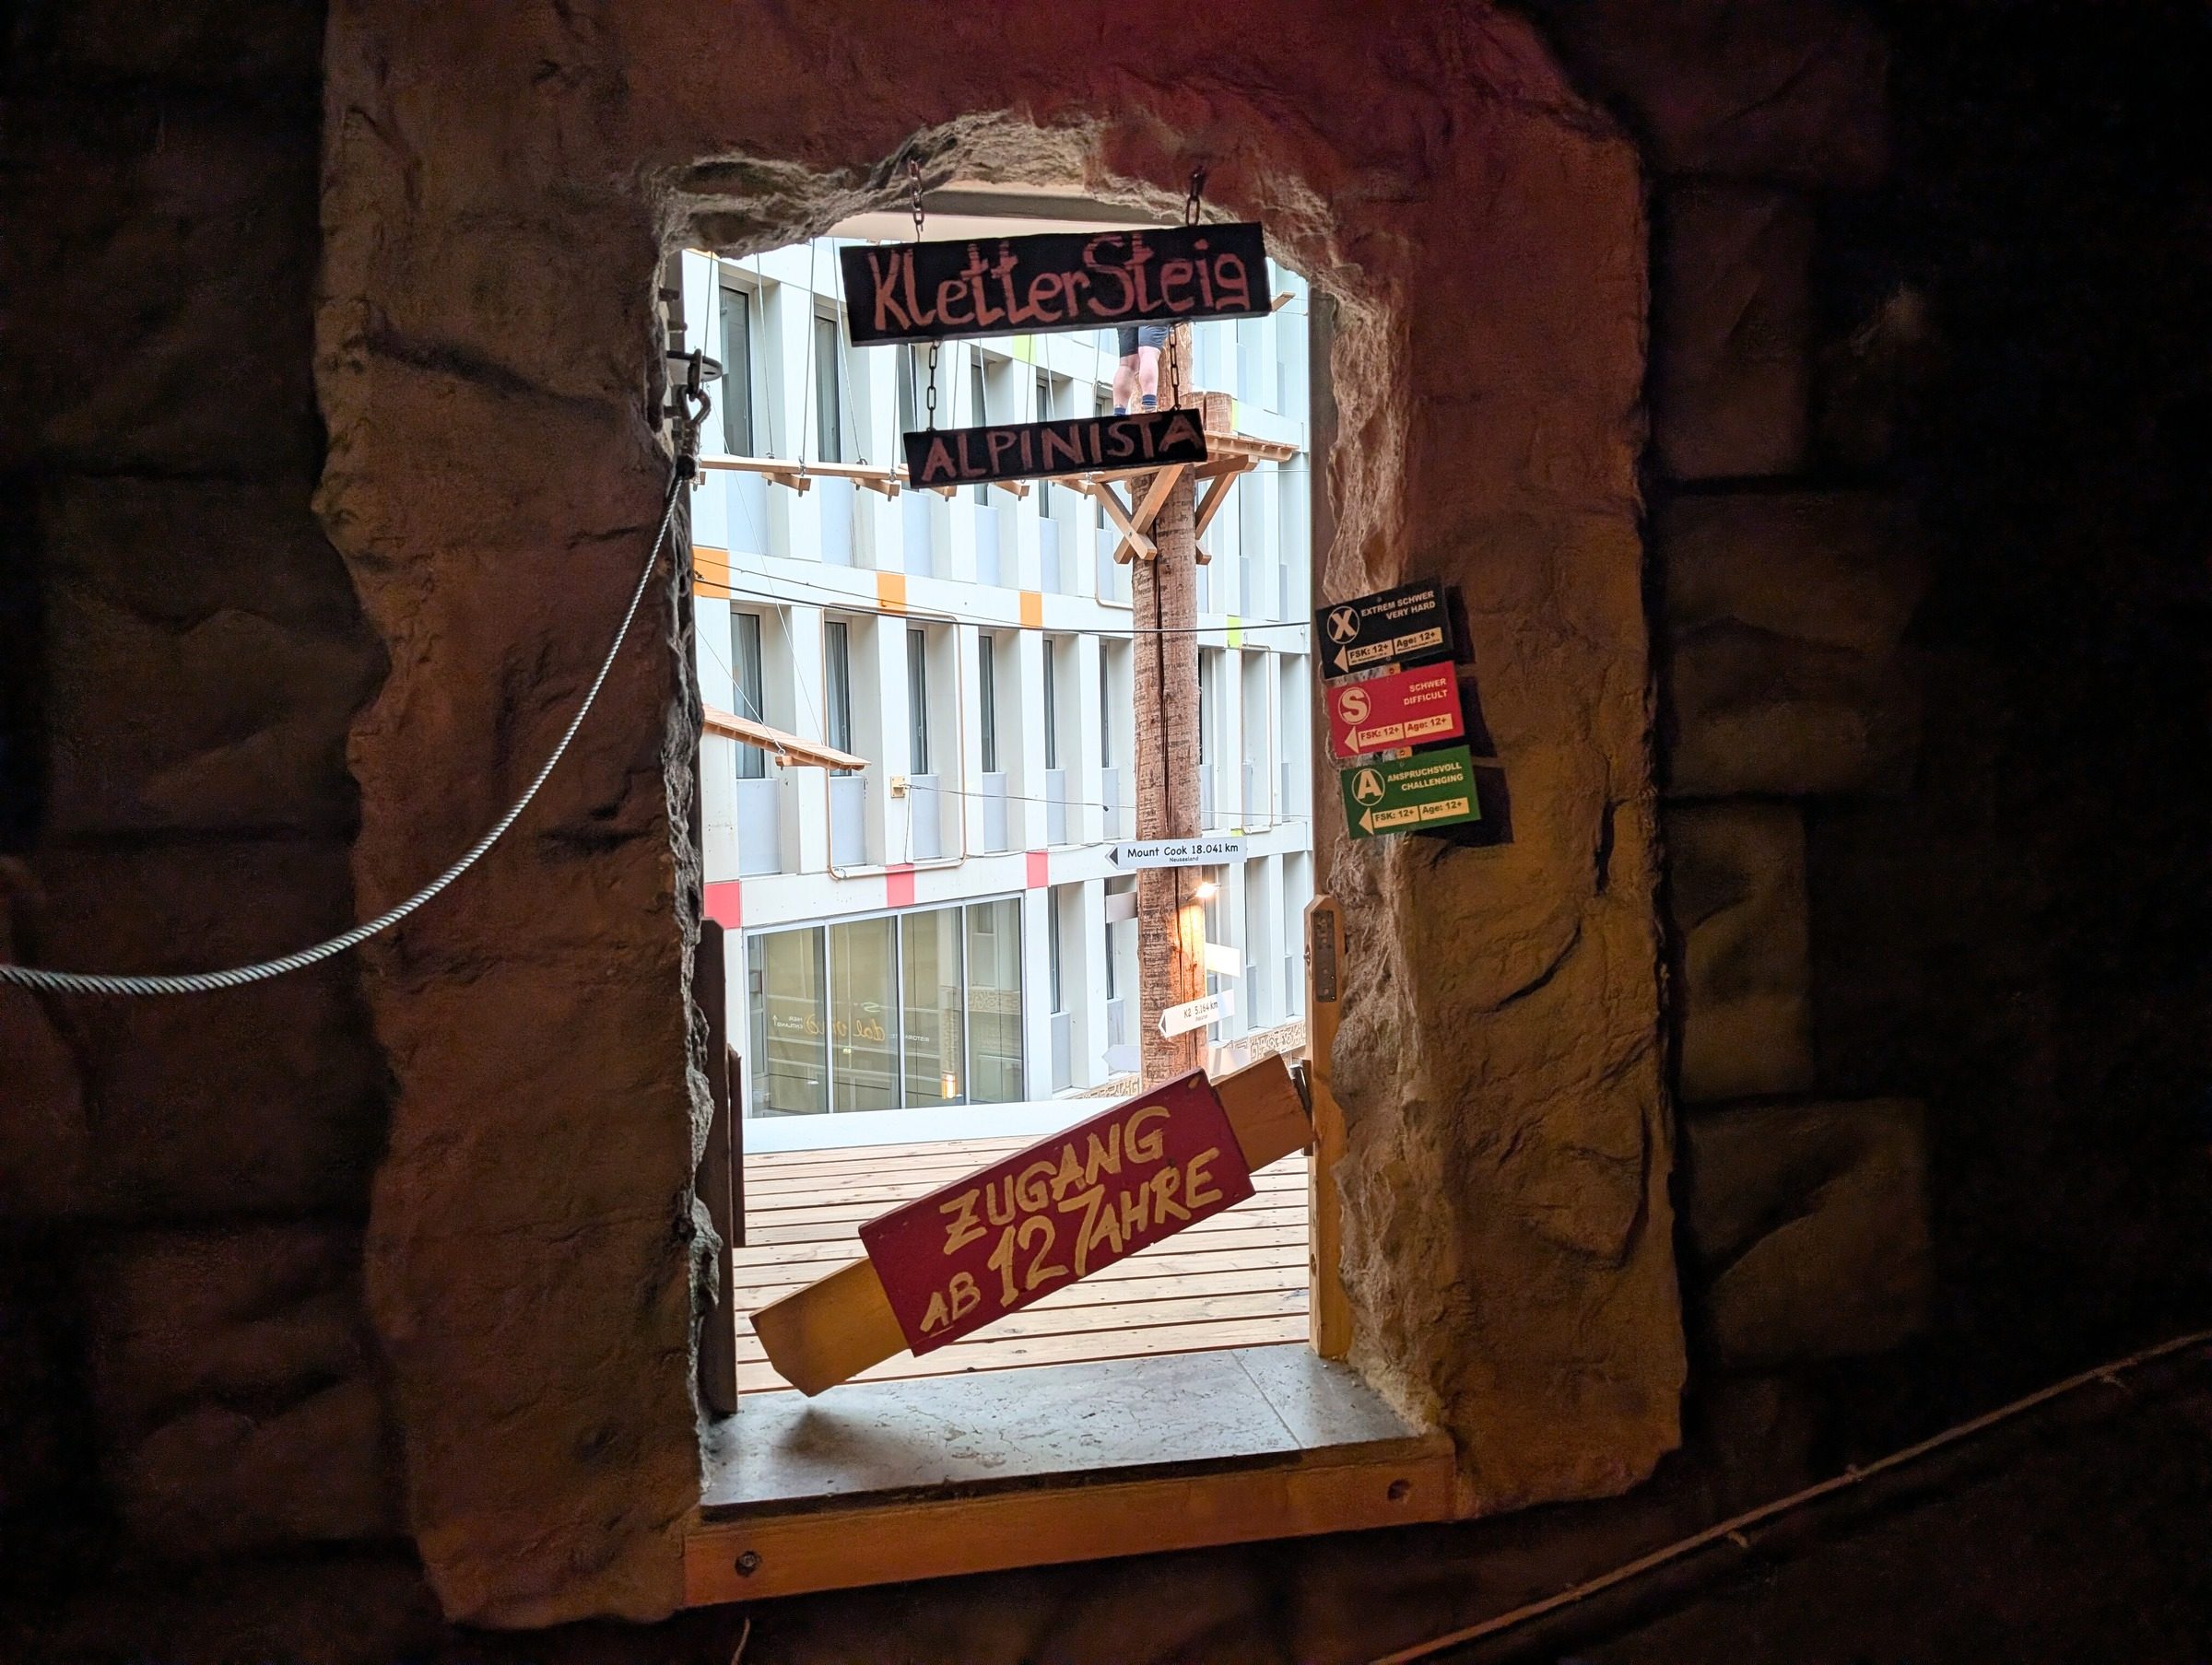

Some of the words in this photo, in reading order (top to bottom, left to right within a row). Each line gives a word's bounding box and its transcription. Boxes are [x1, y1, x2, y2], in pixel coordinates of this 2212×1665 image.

[921, 413, 1202, 482] ALPINISTA
[1360, 601, 1395, 617] EXTREM
[1396, 590, 1435, 608] SCHWER
[1385, 607, 1410, 620] VERY
[1410, 600, 1436, 615] HARD
[1330, 609, 1357, 640] X
[1348, 646, 1371, 659] FSK:
[1371, 642, 1389, 655] 12+
[1395, 636, 1418, 649] Age:
[1418, 631, 1436, 642] 12+
[1408, 677, 1447, 692] SCHWER
[1340, 689, 1369, 722] S
[1403, 689, 1448, 706] DIFFICULT
[1359, 729, 1382, 741] FSK:
[1382, 726, 1400, 737] 12+
[1406, 720, 1429, 733] Age:
[1429, 717, 1447, 728] 12+
[1386, 762, 1463, 782] ANSPRUCHSVOLL
[1400, 773, 1464, 791] CHALLENGING
[1357, 770, 1382, 801] A
[1374, 811, 1396, 823] FSK:
[1396, 809, 1414, 819] 12+
[1421, 803, 1443, 815] Age:
[1444, 800, 1463, 811] 12+
[1127, 847, 1159, 858] Mount
[1163, 846, 1188, 856] Cook
[1191, 844, 1222, 854] 18.041
[1225, 842, 1239, 852] km
[1183, 1008, 1192, 1018] K2
[1210, 1001, 1218, 1011] km
[938, 1105, 1171, 1256] ZUGANG
[919, 1271, 982, 1333] AB
[987, 1214, 1070, 1308] 12
